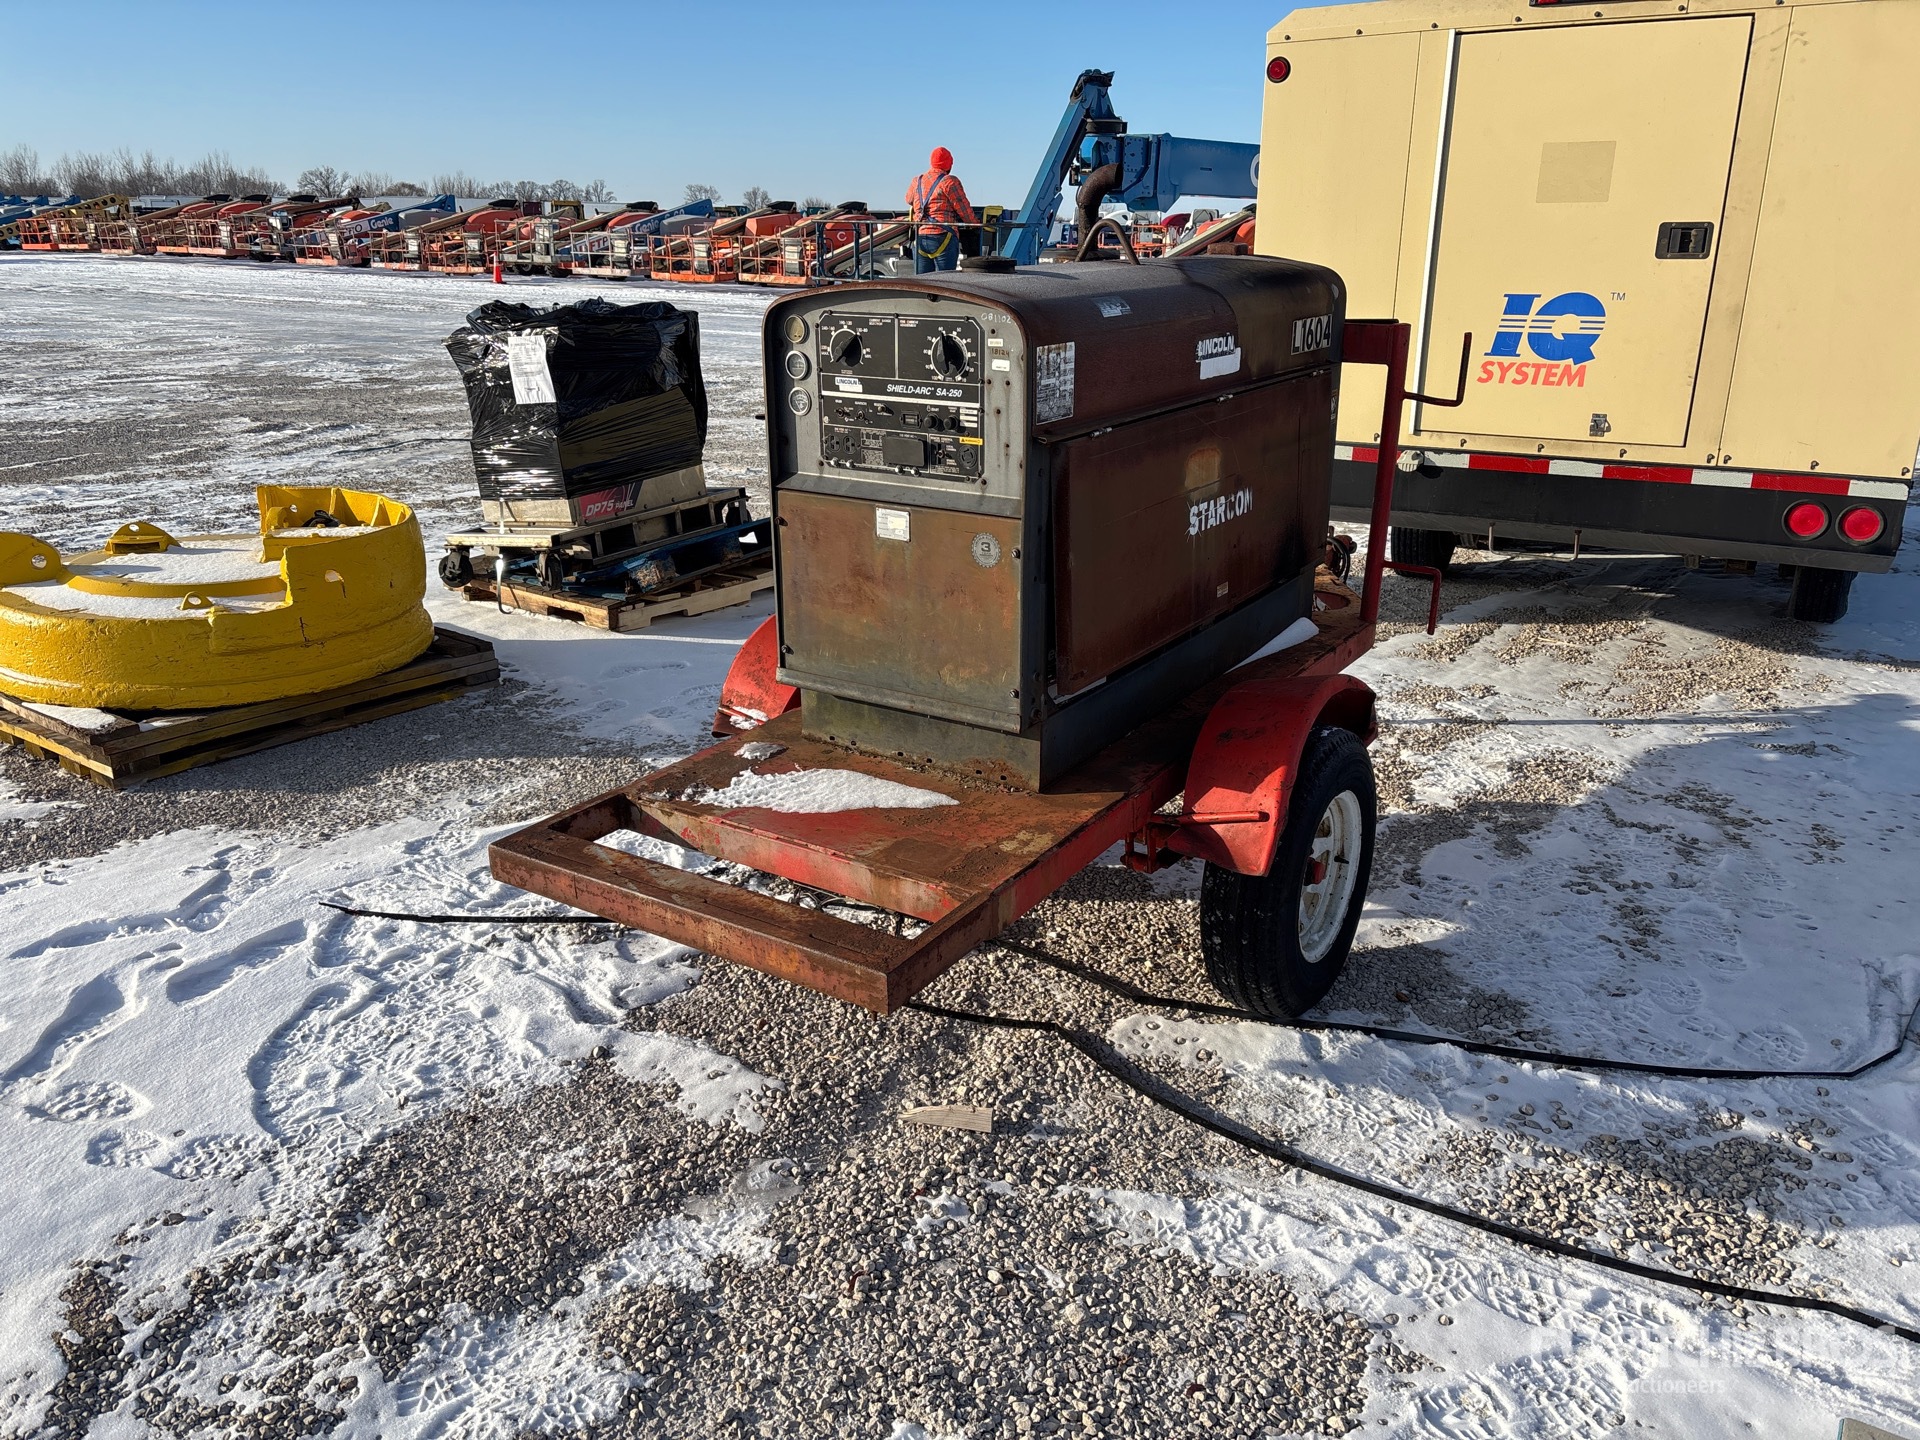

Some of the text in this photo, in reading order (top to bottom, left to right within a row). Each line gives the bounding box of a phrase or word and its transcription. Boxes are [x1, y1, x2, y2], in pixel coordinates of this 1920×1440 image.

[370, 216, 394, 230] Genie
[635, 219, 659, 233] Genie
[1292, 314, 1332, 354] L1604
[1484, 291, 1626, 365] IQ TM
[1198, 335, 1235, 357] LINCOLN
[836, 378, 858, 386] LINCOLN
[1477, 360, 1587, 388] SYSTEM
[935, 388, 963, 398] SA-250
[585, 499, 615, 517] DP75
[1189, 487, 1253, 536] STARCOM
[981, 541, 992, 552] 3
